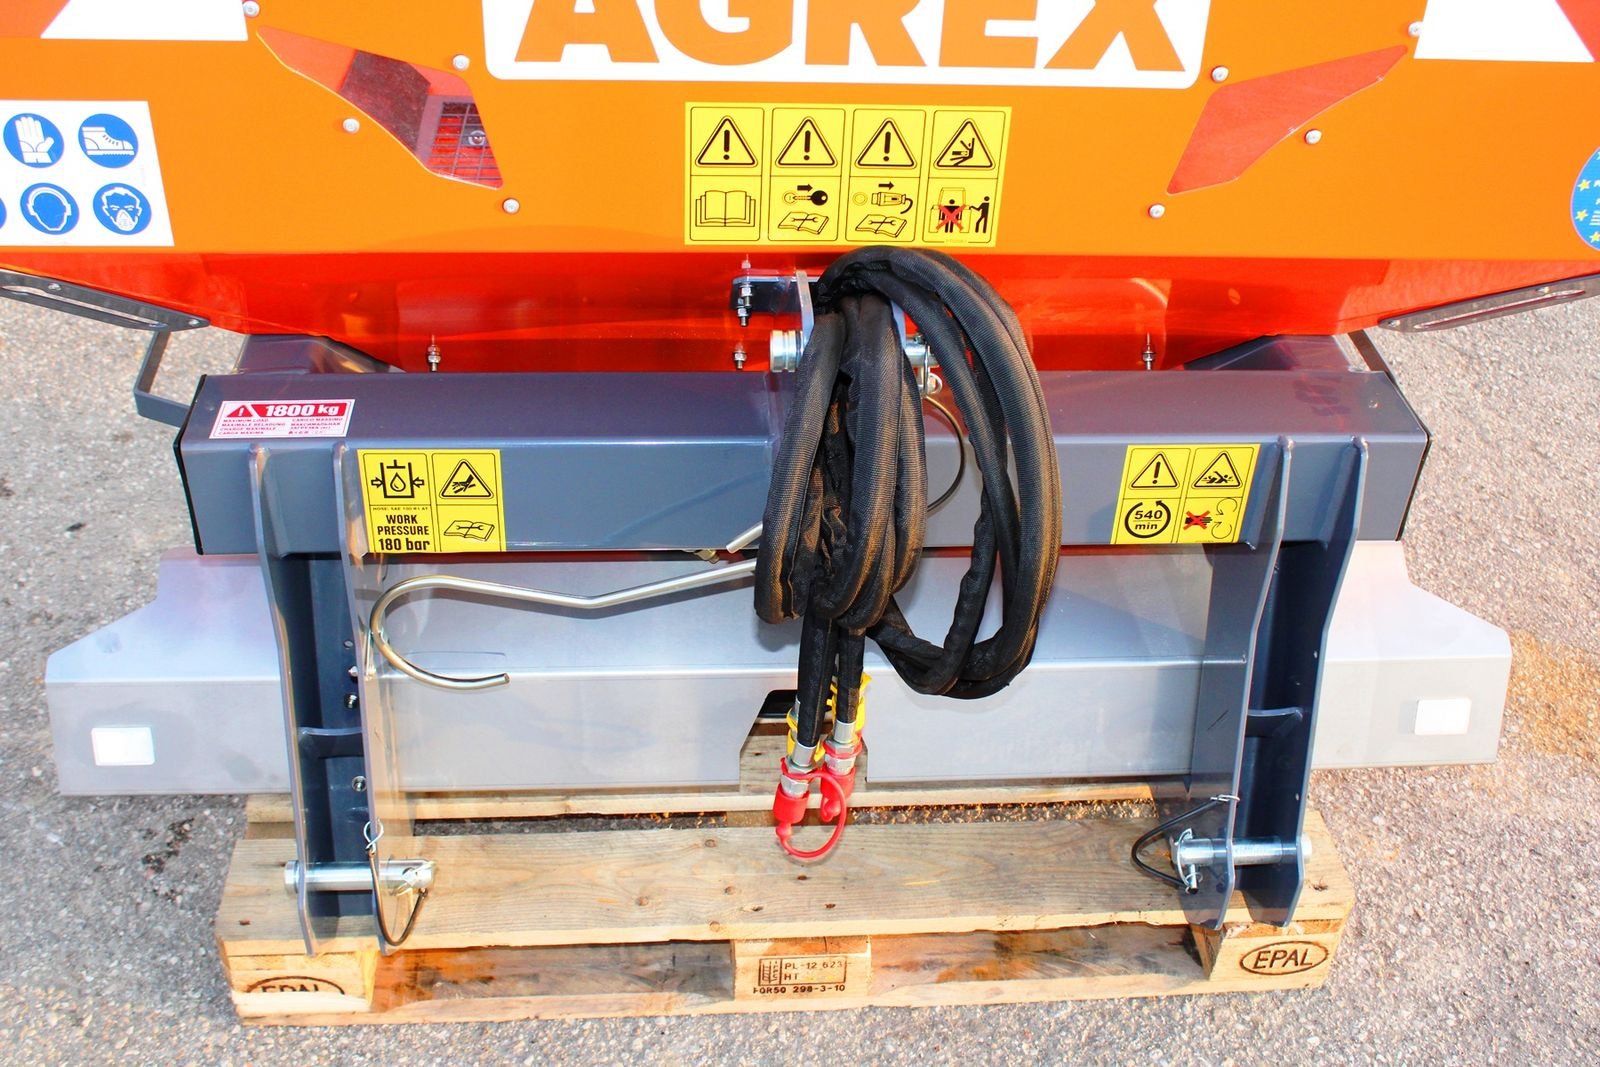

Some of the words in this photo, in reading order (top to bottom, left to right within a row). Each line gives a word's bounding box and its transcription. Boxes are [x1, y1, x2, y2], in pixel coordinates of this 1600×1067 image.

[514, 0, 1186, 71] AGREX
[265, 404, 315, 417] 1800
[317, 403, 339, 416] kg
[385, 514, 418, 524] WORK
[1134, 510, 1163, 520] 540
[377, 525, 430, 535] PRESSURE
[1134, 522, 1158, 530] min
[378, 537, 402, 551] 180
[405, 537, 430, 551] bar
[1253, 948, 1313, 970] EPAL
